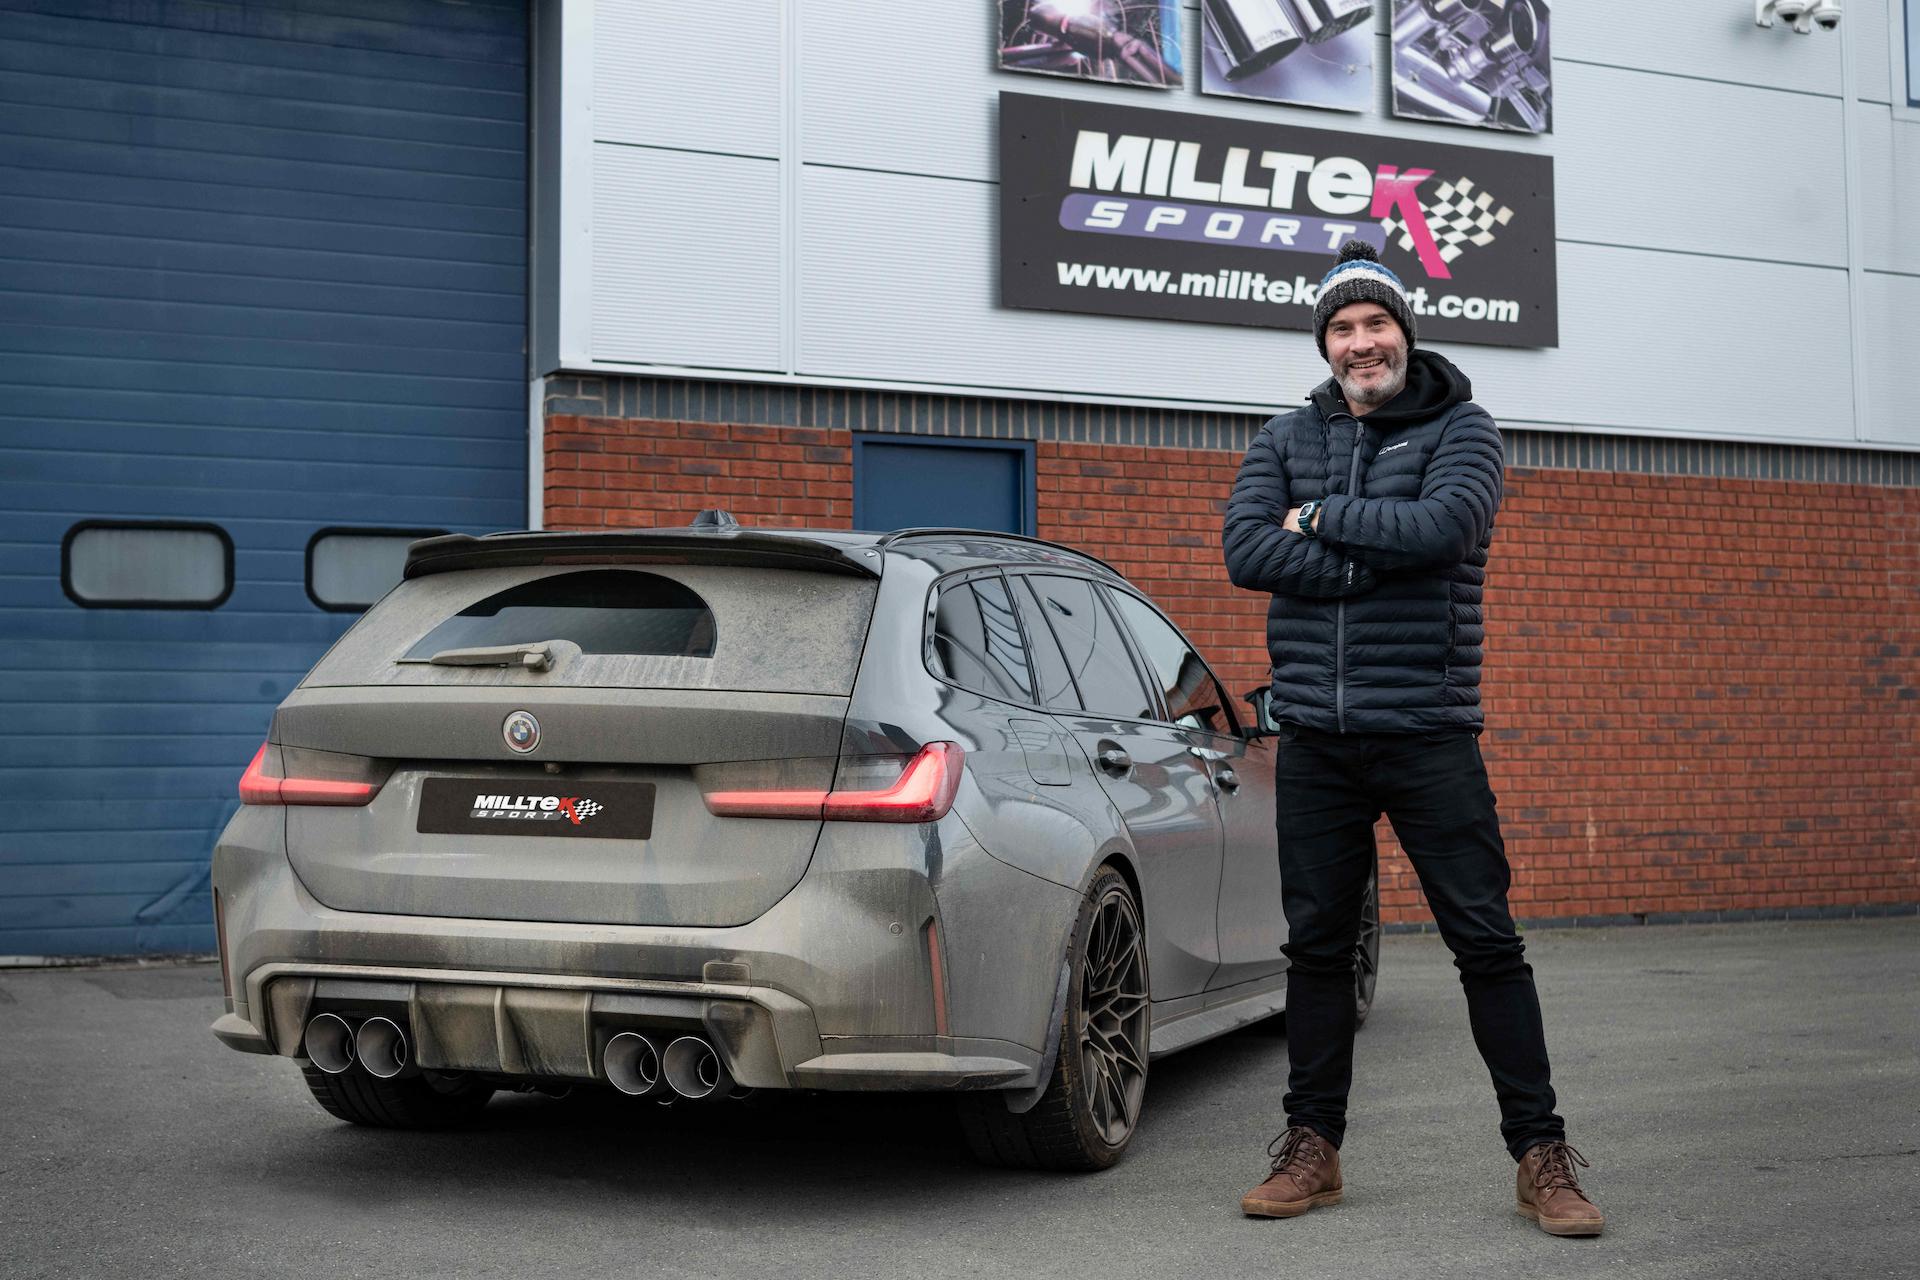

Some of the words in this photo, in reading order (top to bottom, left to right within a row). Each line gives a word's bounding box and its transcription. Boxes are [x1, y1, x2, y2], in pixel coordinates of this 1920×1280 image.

[1084, 200, 1356, 250] SPORT
[1056, 262, 1520, 323] www.milltekt.com
[476, 810, 554, 820] SPORT
